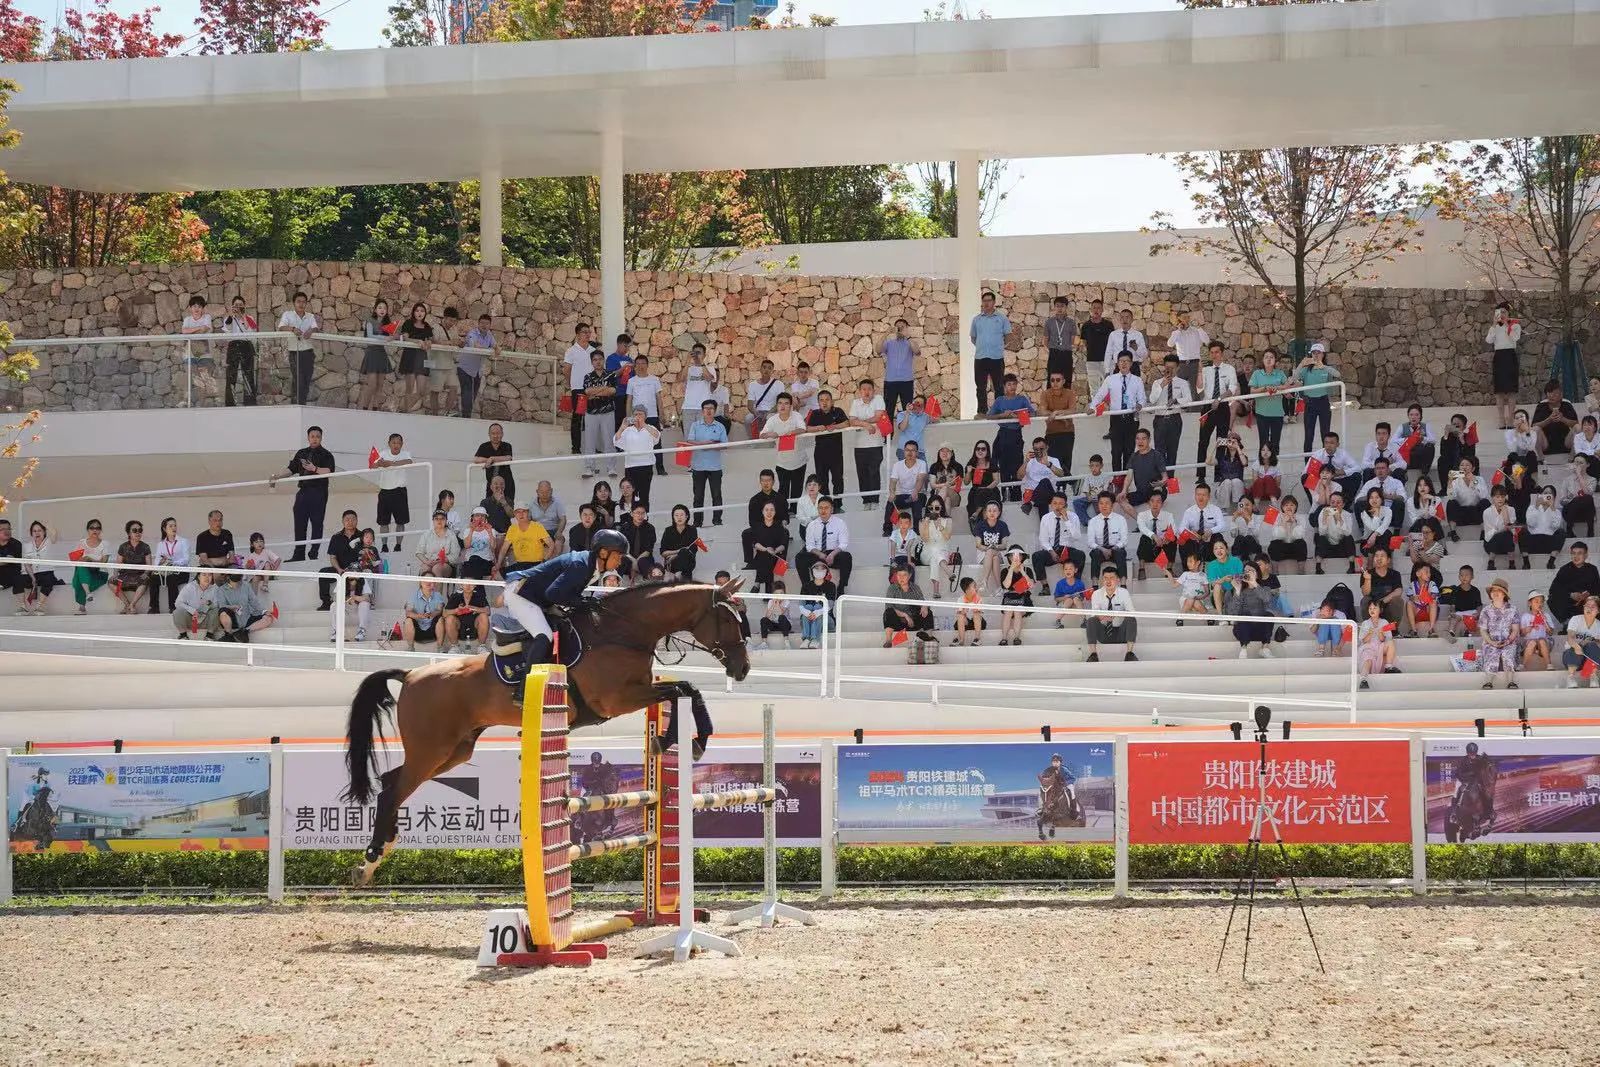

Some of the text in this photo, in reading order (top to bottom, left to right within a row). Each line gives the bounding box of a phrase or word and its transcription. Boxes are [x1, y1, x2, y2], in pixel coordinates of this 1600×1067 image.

[69, 767, 85, 775] 2023
[906, 770, 968, 783] 贵阳铁建城
[1202, 758, 1337, 790] 贵阳铁建城
[68, 774, 99, 785] 铁建杯
[858, 784, 996, 797] 祖平马术TCR精英训练营
[1527, 791, 1600, 807] 祖平马术T
[1151, 794, 1391, 826] 中国都市文化示范区
[294, 834, 521, 846] GUIYANG INTERONAL EQUESTRIAN CENT
[488, 924, 518, 954] 10
